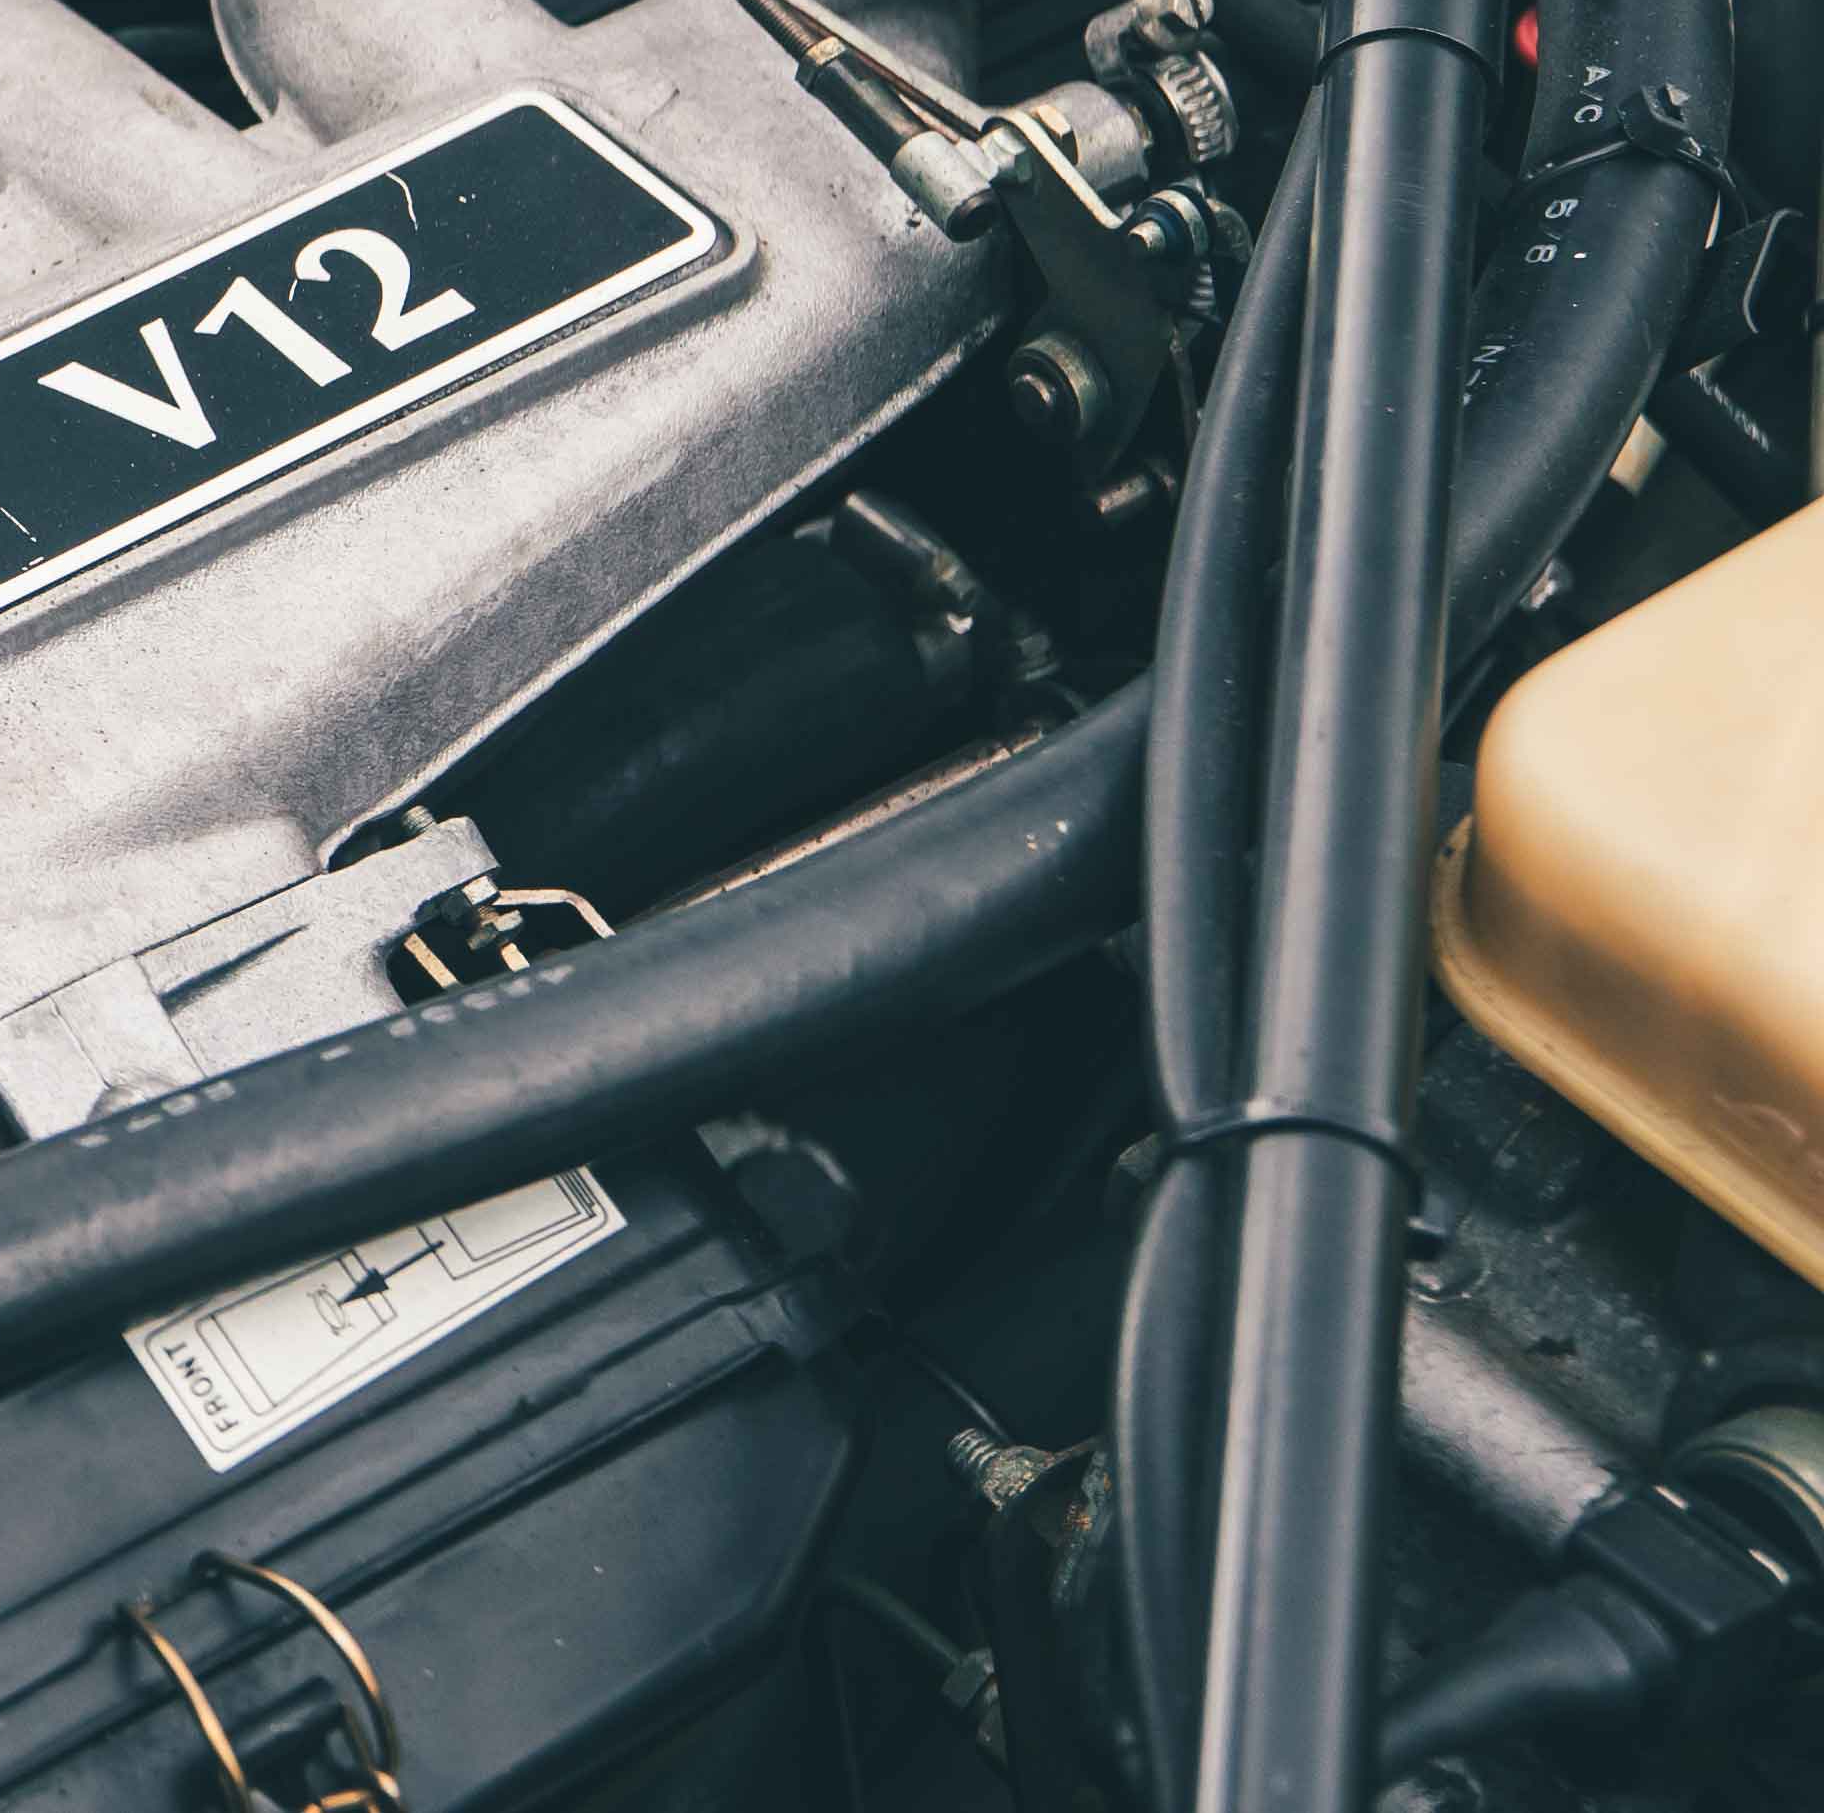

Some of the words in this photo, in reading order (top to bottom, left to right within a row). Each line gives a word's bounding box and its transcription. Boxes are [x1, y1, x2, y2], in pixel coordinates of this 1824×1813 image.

[1574, 66, 1612, 124] A/C
[1525, 198, 1579, 263] 5/8
[36, 224, 478, 451] V12
[162, 1341, 240, 1434] FRONT
